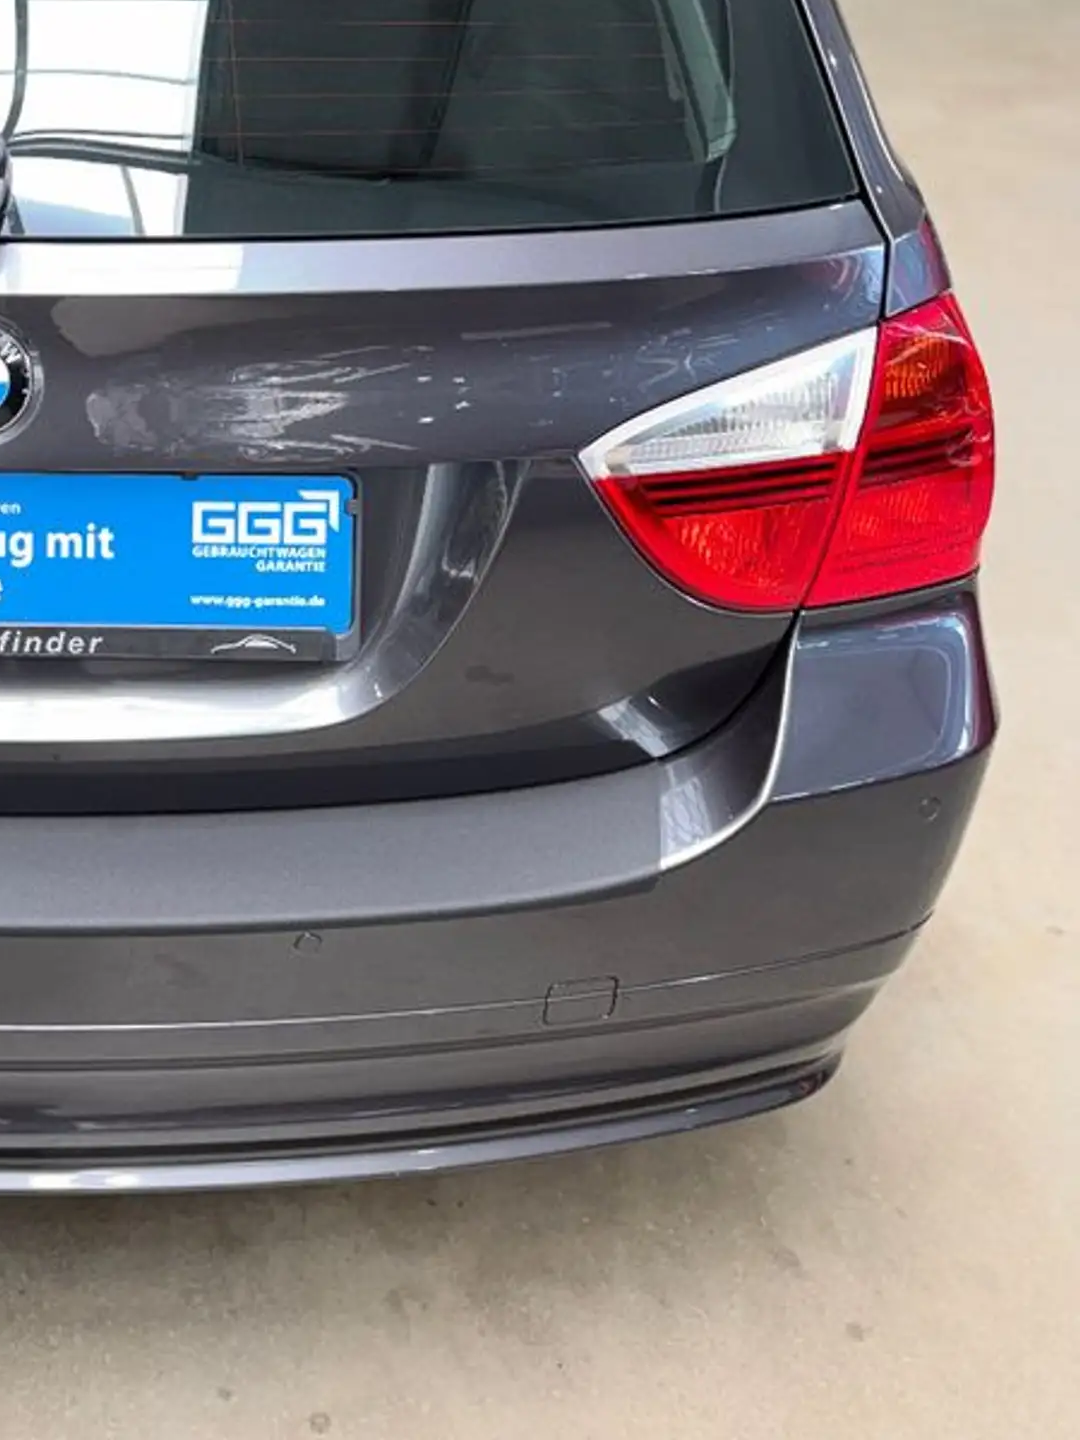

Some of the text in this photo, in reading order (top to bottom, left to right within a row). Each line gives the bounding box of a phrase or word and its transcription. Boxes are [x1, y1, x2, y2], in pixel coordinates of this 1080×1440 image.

[192, 500, 328, 544] GGG
[46, 523, 115, 559] mit
[192, 544, 327, 559] GEBRAUCHTWAGEN
[255, 560, 326, 573] GARANTIE
